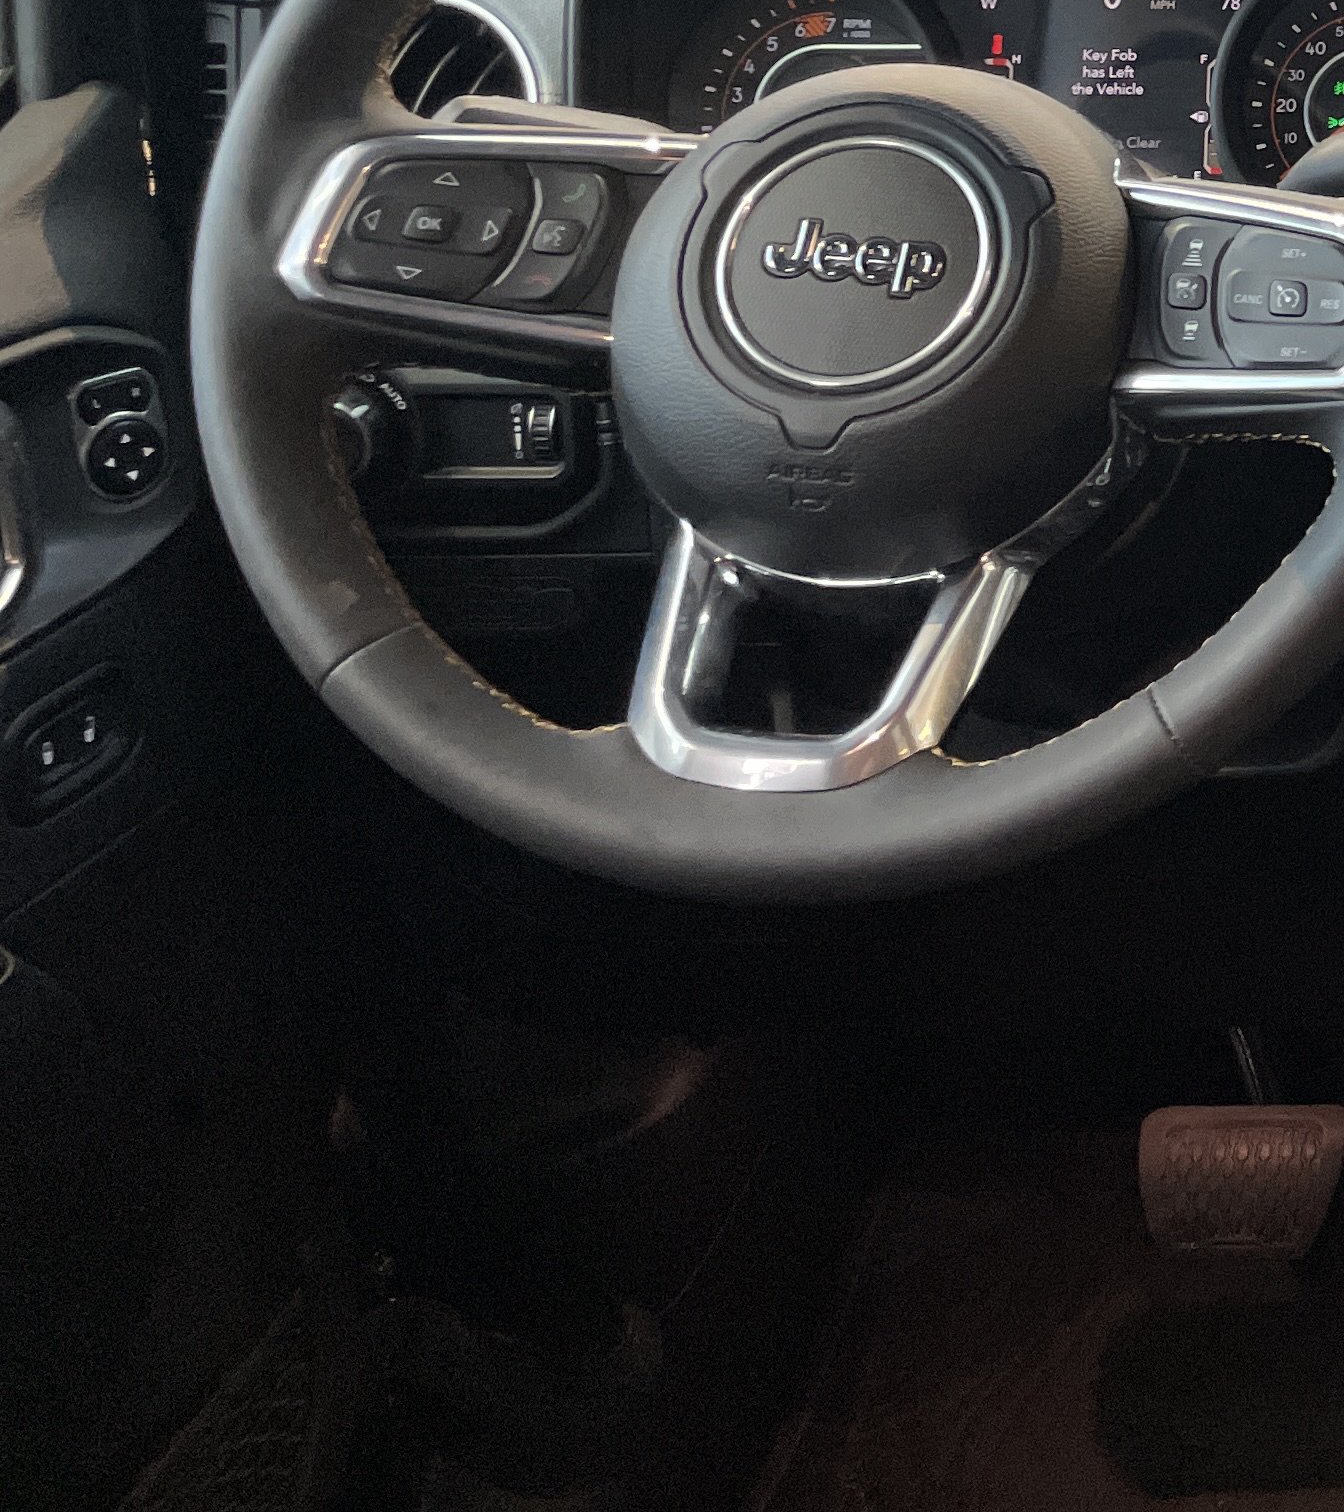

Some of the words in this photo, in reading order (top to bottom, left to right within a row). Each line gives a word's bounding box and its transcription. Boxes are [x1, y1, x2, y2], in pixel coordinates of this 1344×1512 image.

[1150, 0, 1176, 10] MPH
[795, 23, 807, 37] 6
[825, 18, 836, 33] 7
[766, 37, 778, 52] 5
[1305, 41, 1327, 56] 40
[1011, 54, 1022, 64] H
[1082, 49, 1109, 63] Key
[1111, 49, 1137, 62] Fob
[1200, 54, 1208, 64] F
[744, 59, 755, 74] 4
[1082, 66, 1105, 78] has
[1109, 66, 1134, 78] Left
[1288, 69, 1305, 82] 30
[732, 87, 743, 103] 3
[1072, 83, 1093, 95] the
[1096, 83, 1144, 95] Vehicle
[1275, 98, 1297, 113] 20
[1126, 137, 1162, 149] Clear
[1284, 132, 1298, 144] 10
[417, 216, 442, 230] OK
[761, 218, 947, 299] Jeep
[1233, 294, 1263, 304] CANC
[1320, 299, 1340, 310] RES
